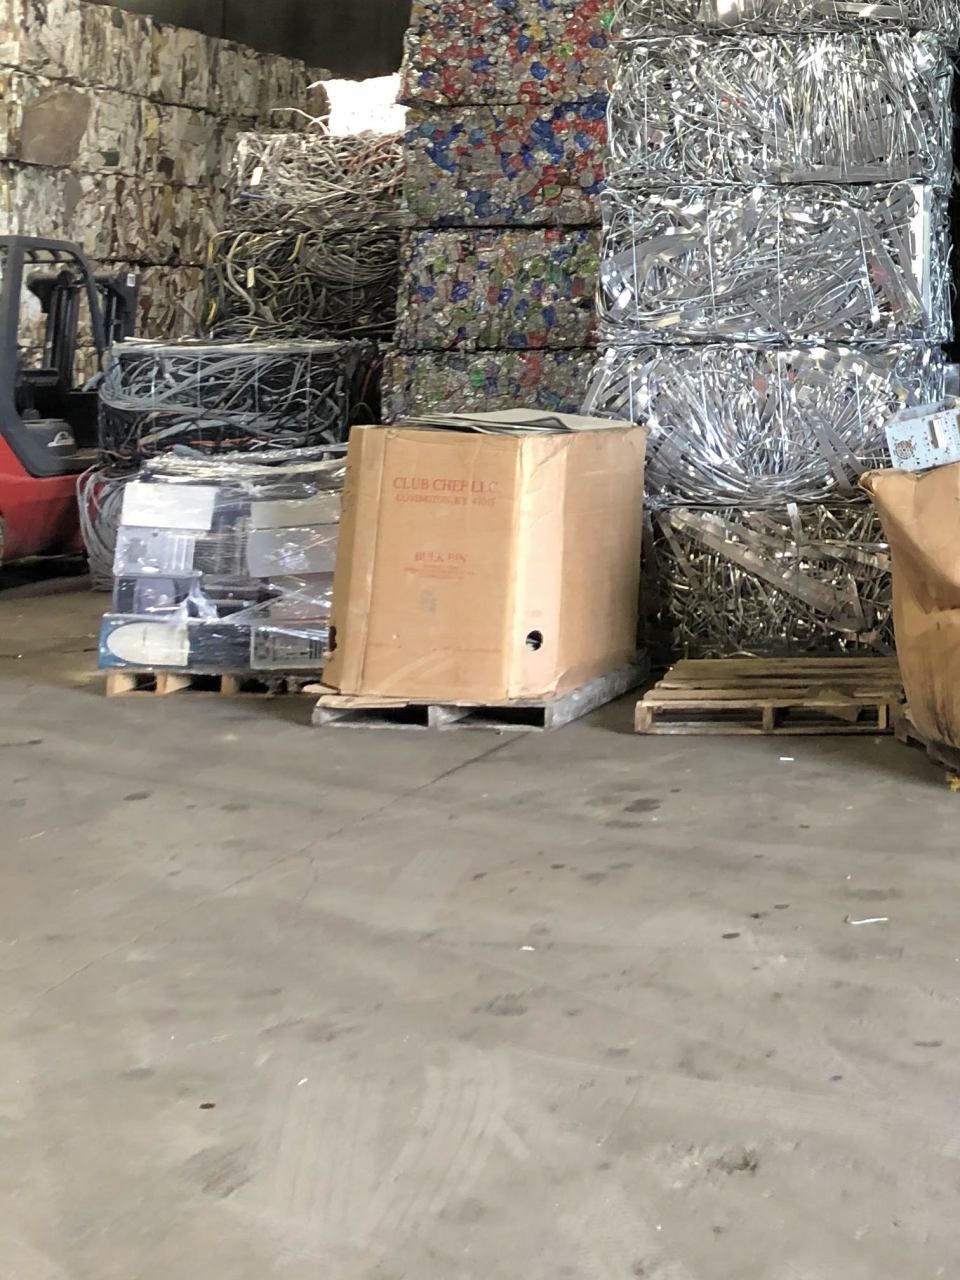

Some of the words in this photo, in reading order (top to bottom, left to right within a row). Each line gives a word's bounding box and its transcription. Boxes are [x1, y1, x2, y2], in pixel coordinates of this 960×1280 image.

[393, 477, 429, 490] CLUB
[432, 479, 468, 492] CHEF
[471, 480, 499, 493] LLC
